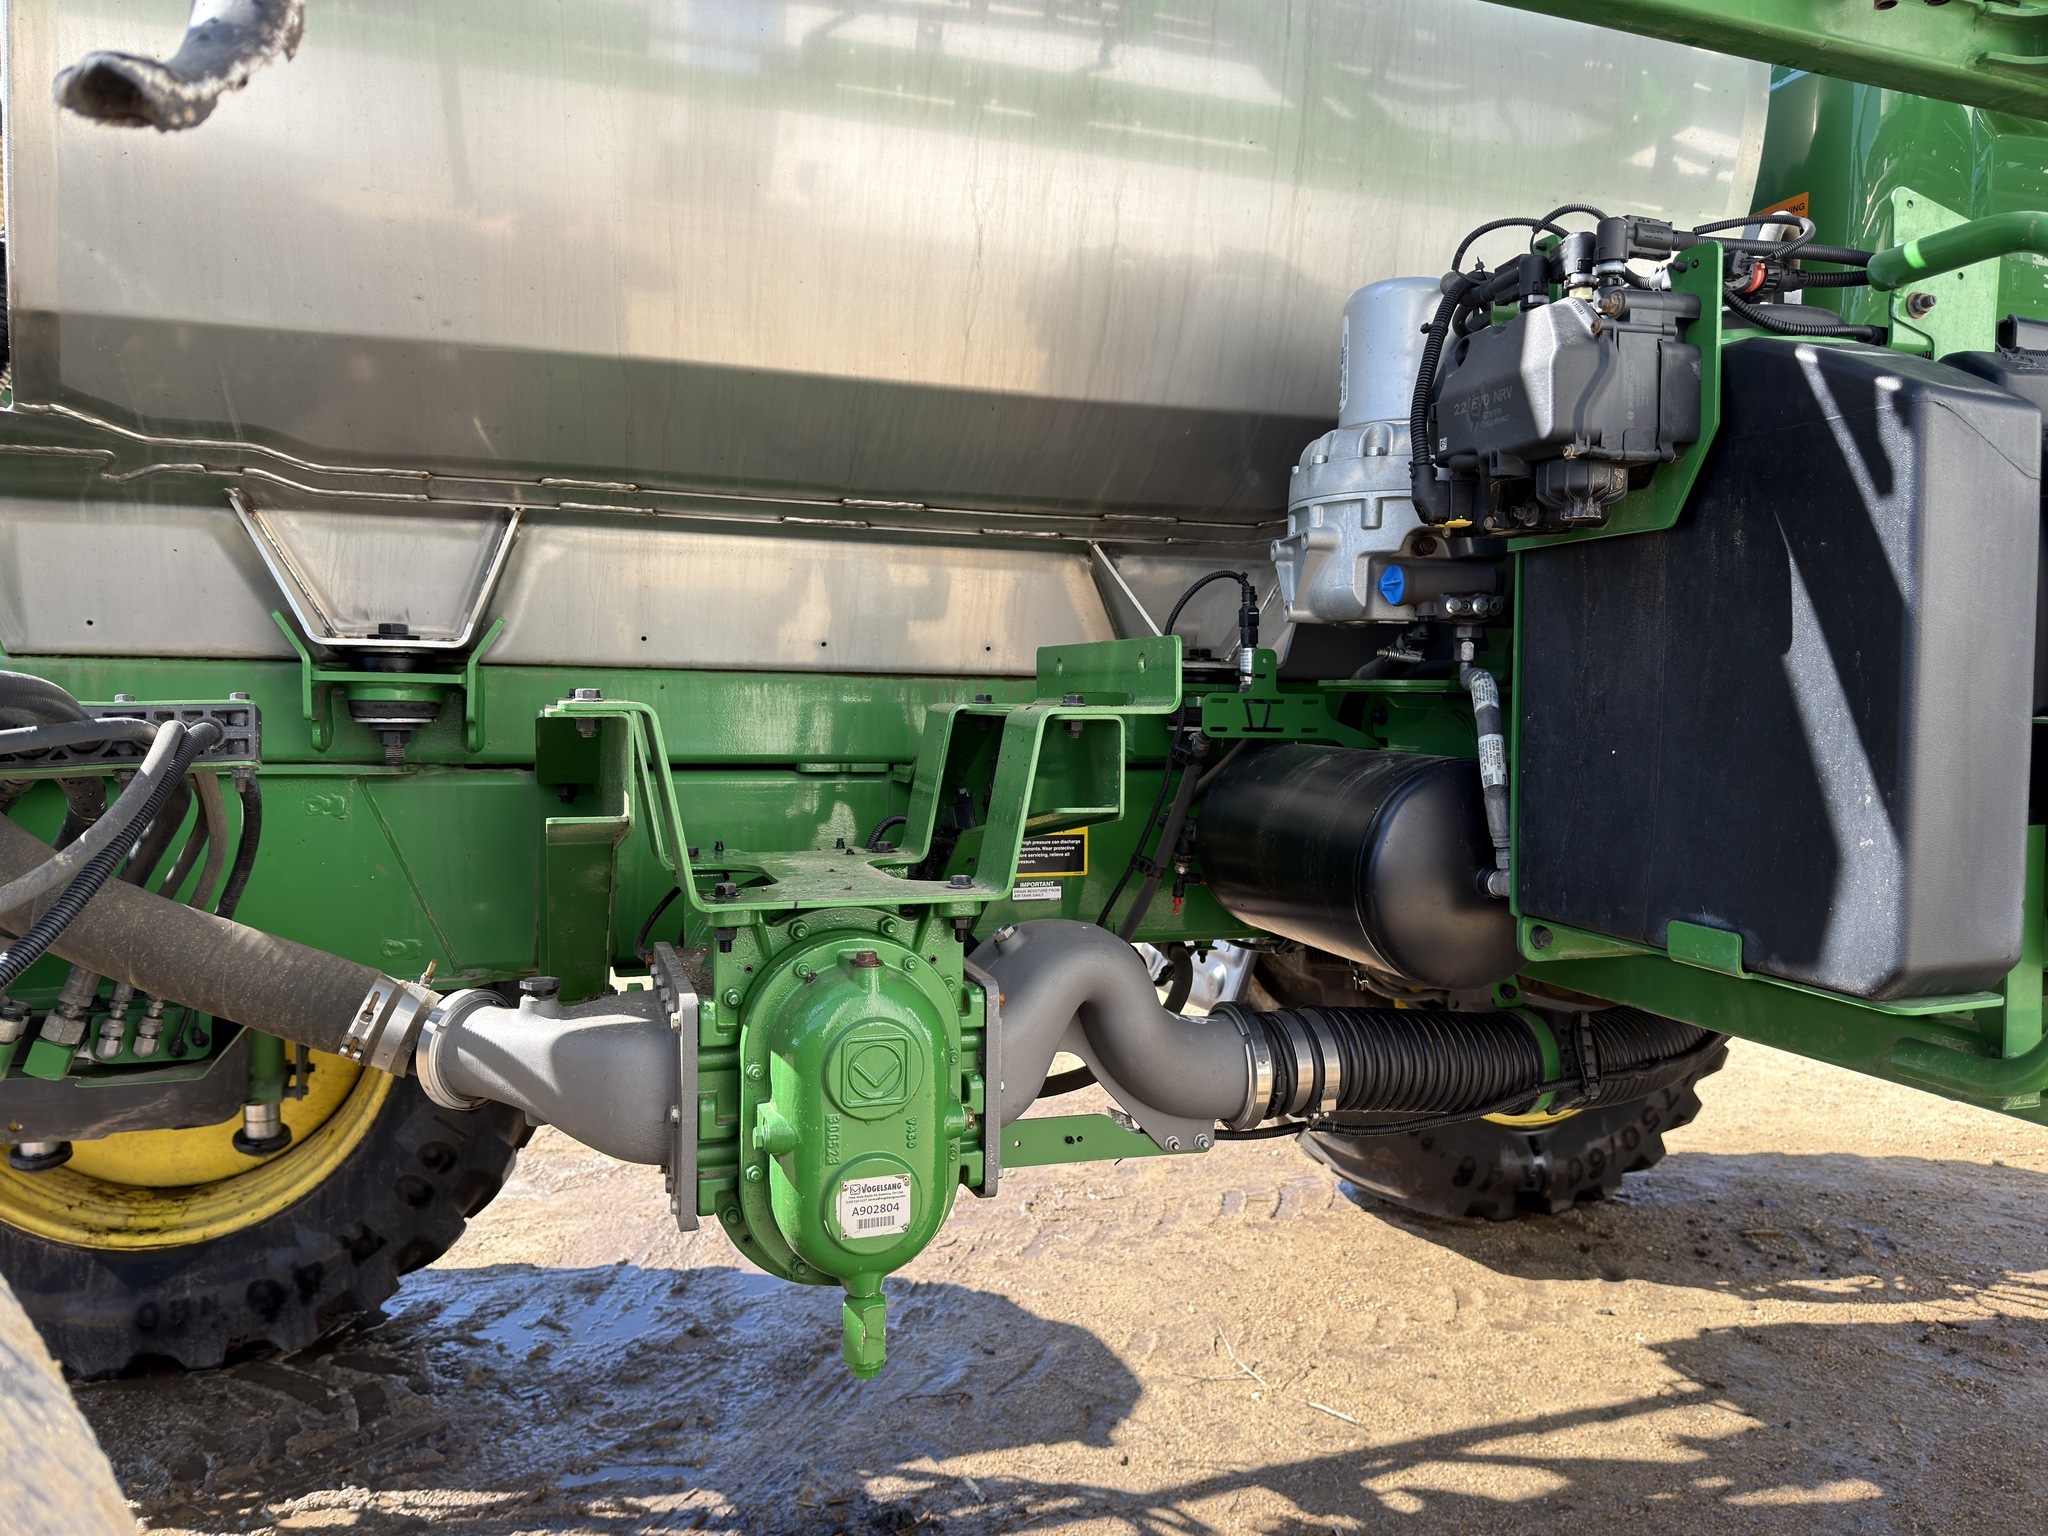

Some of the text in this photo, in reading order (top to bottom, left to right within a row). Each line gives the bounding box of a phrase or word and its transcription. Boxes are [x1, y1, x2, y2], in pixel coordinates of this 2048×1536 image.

[1471, 393, 1490, 410] EVO
[1493, 386, 1513, 403] NRV
[862, 1182, 902, 1193] VOGELSANG
[851, 1202, 900, 1217] A902804
